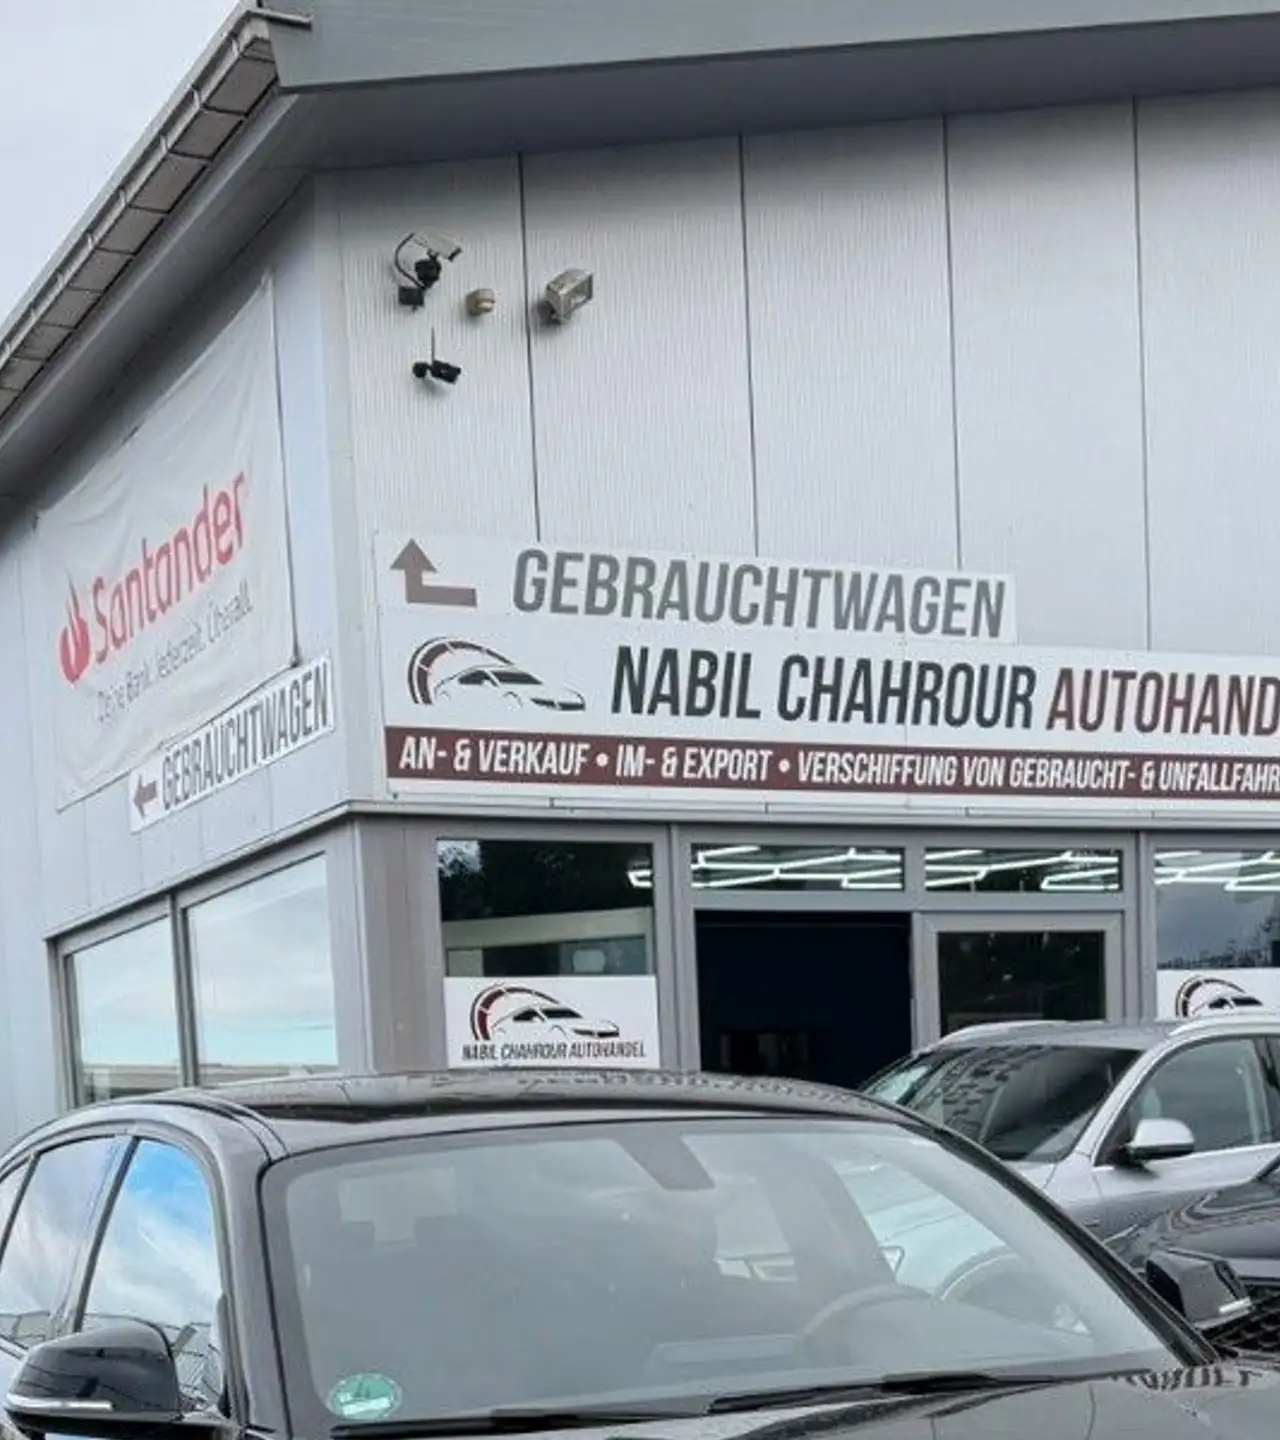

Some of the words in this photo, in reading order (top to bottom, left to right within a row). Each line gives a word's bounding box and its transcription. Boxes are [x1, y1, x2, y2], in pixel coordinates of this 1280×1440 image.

[93, 471, 245, 664] Santander
[513, 549, 1006, 638] GEBRAUCHTWAGEN
[612, 645, 761, 720] NABIL
[777, 653, 1036, 730] CHAHROUR
[161, 660, 329, 811] GEBRAUCHTWAGEN
[399, 736, 447, 771] AN-
[453, 739, 471, 772] &
[478, 740, 591, 775] VERKAUF
[616, 744, 655, 778] IM-
[661, 746, 678, 779] &
[683, 747, 774, 781] EXPORT
[798, 750, 957, 787] VERSCHIFFUNG
[963, 755, 1006, 788] VON
[1009, 757, 1136, 790] GEBRAUCHT-
[1140, 761, 1155, 791] &
[569, 1041, 646, 1059] AUTOHANDEL
